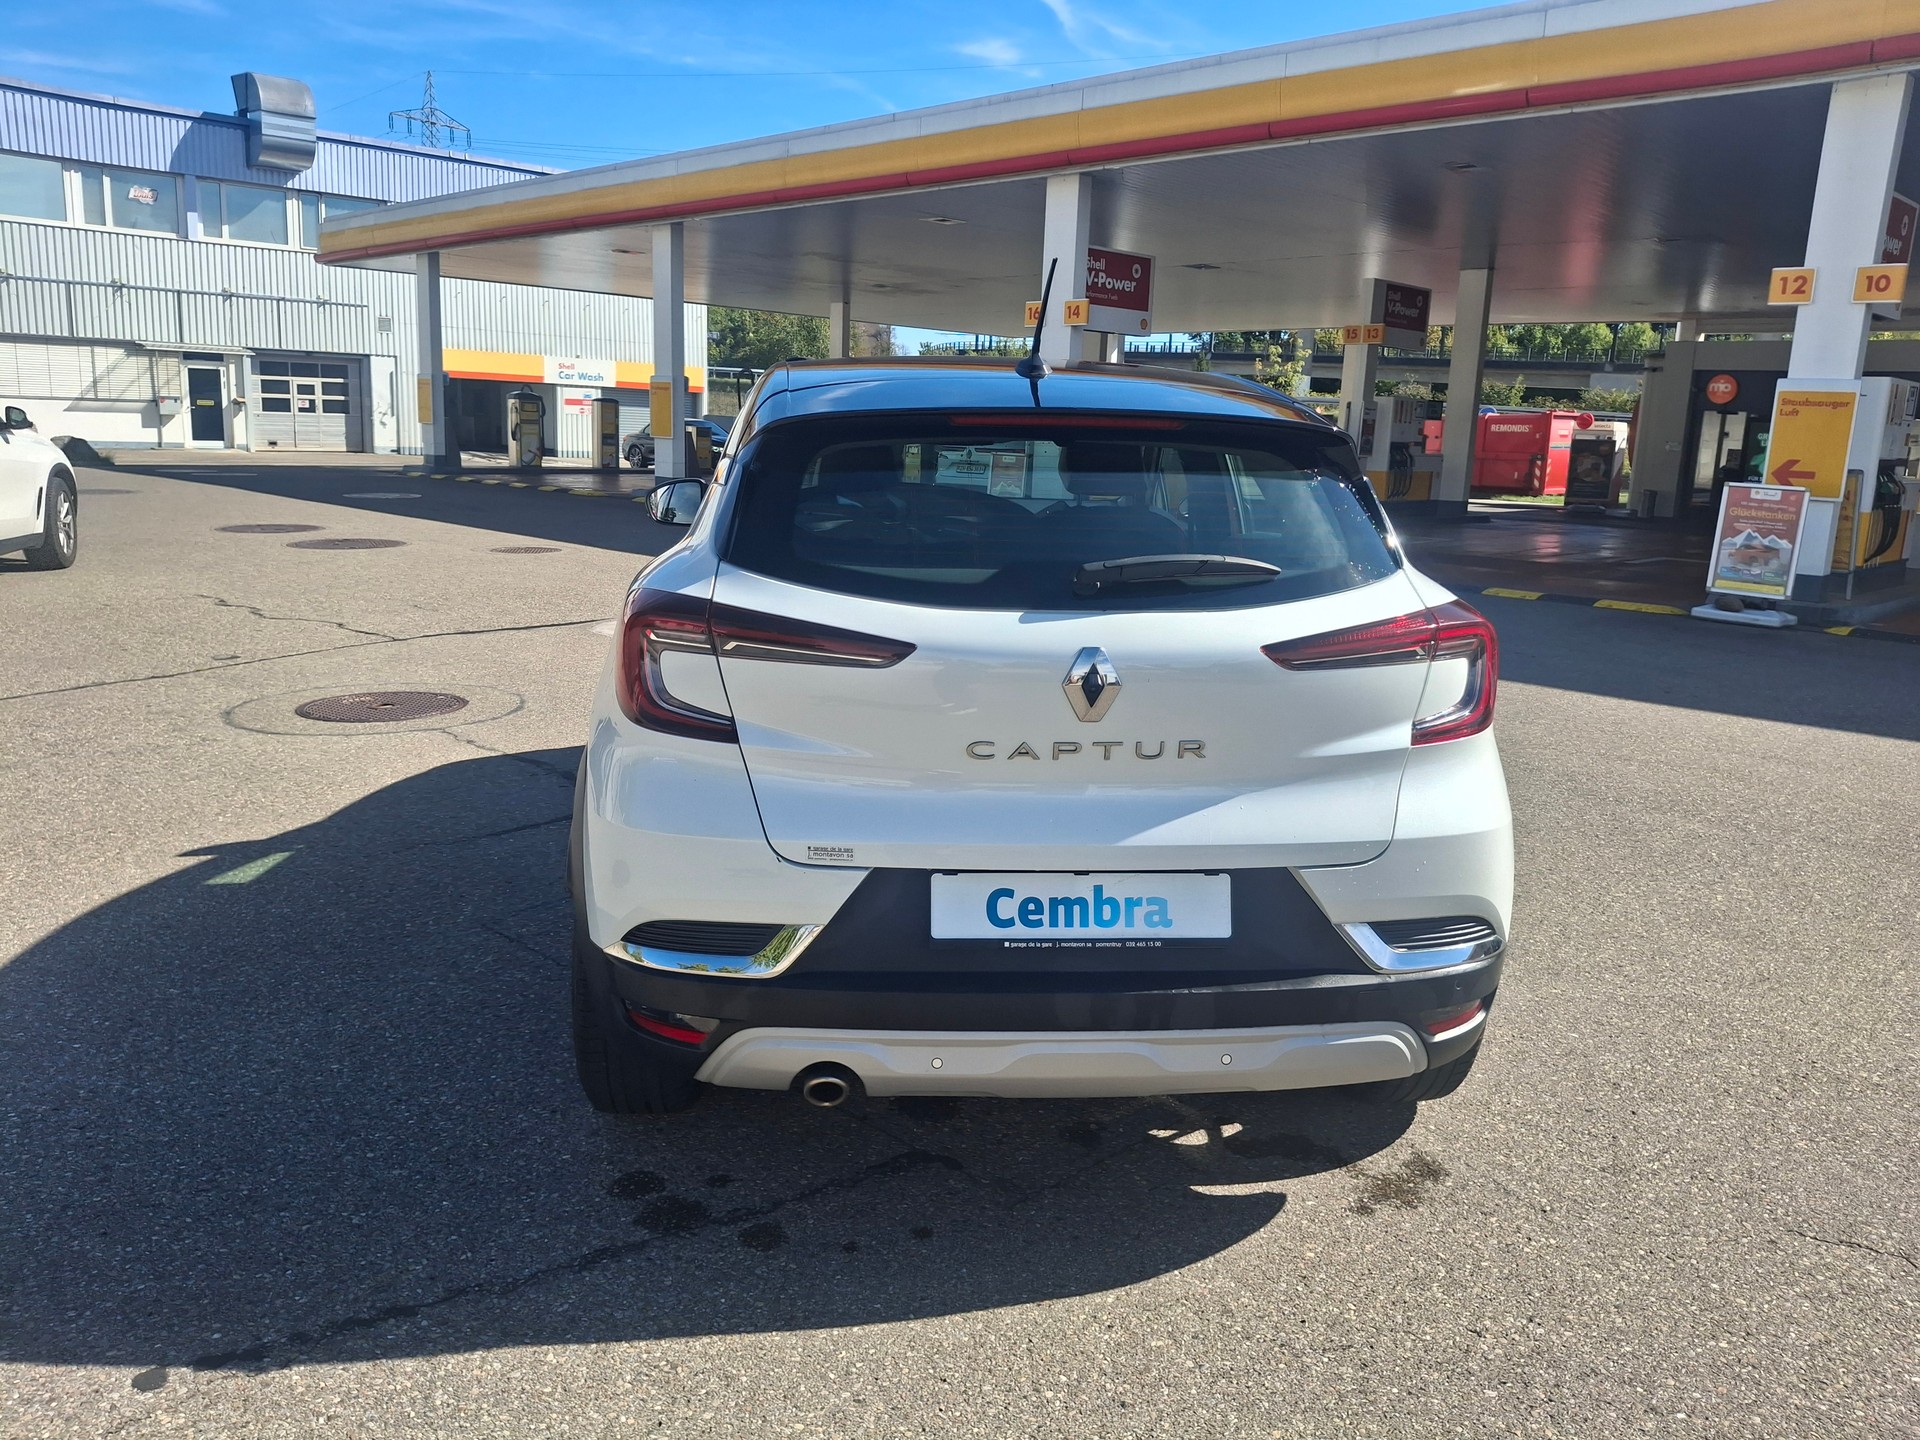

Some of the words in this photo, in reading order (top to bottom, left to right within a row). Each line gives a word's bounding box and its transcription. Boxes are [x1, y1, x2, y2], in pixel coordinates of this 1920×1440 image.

[1086, 257, 1106, 271] Shell
[1086, 272, 1137, 292] V-Power
[1779, 275, 1808, 295] 12
[1866, 274, 1891, 293] 10
[1028, 307, 1040, 320] 16
[1066, 305, 1080, 319] 14
[1387, 301, 1420, 317] V-Power
[1346, 329, 1358, 339] 15
[1367, 328, 1379, 339] 13
[558, 362, 575, 370] Shell
[558, 371, 575, 380] Car
[578, 372, 604, 382] Wash
[1781, 398, 1850, 409] Staubsauger
[1780, 408, 1799, 417] Luft
[1729, 507, 1796, 521] Glückstanken
[966, 739, 1206, 760] CAPTUR
[986, 885, 1173, 929] Cembra
